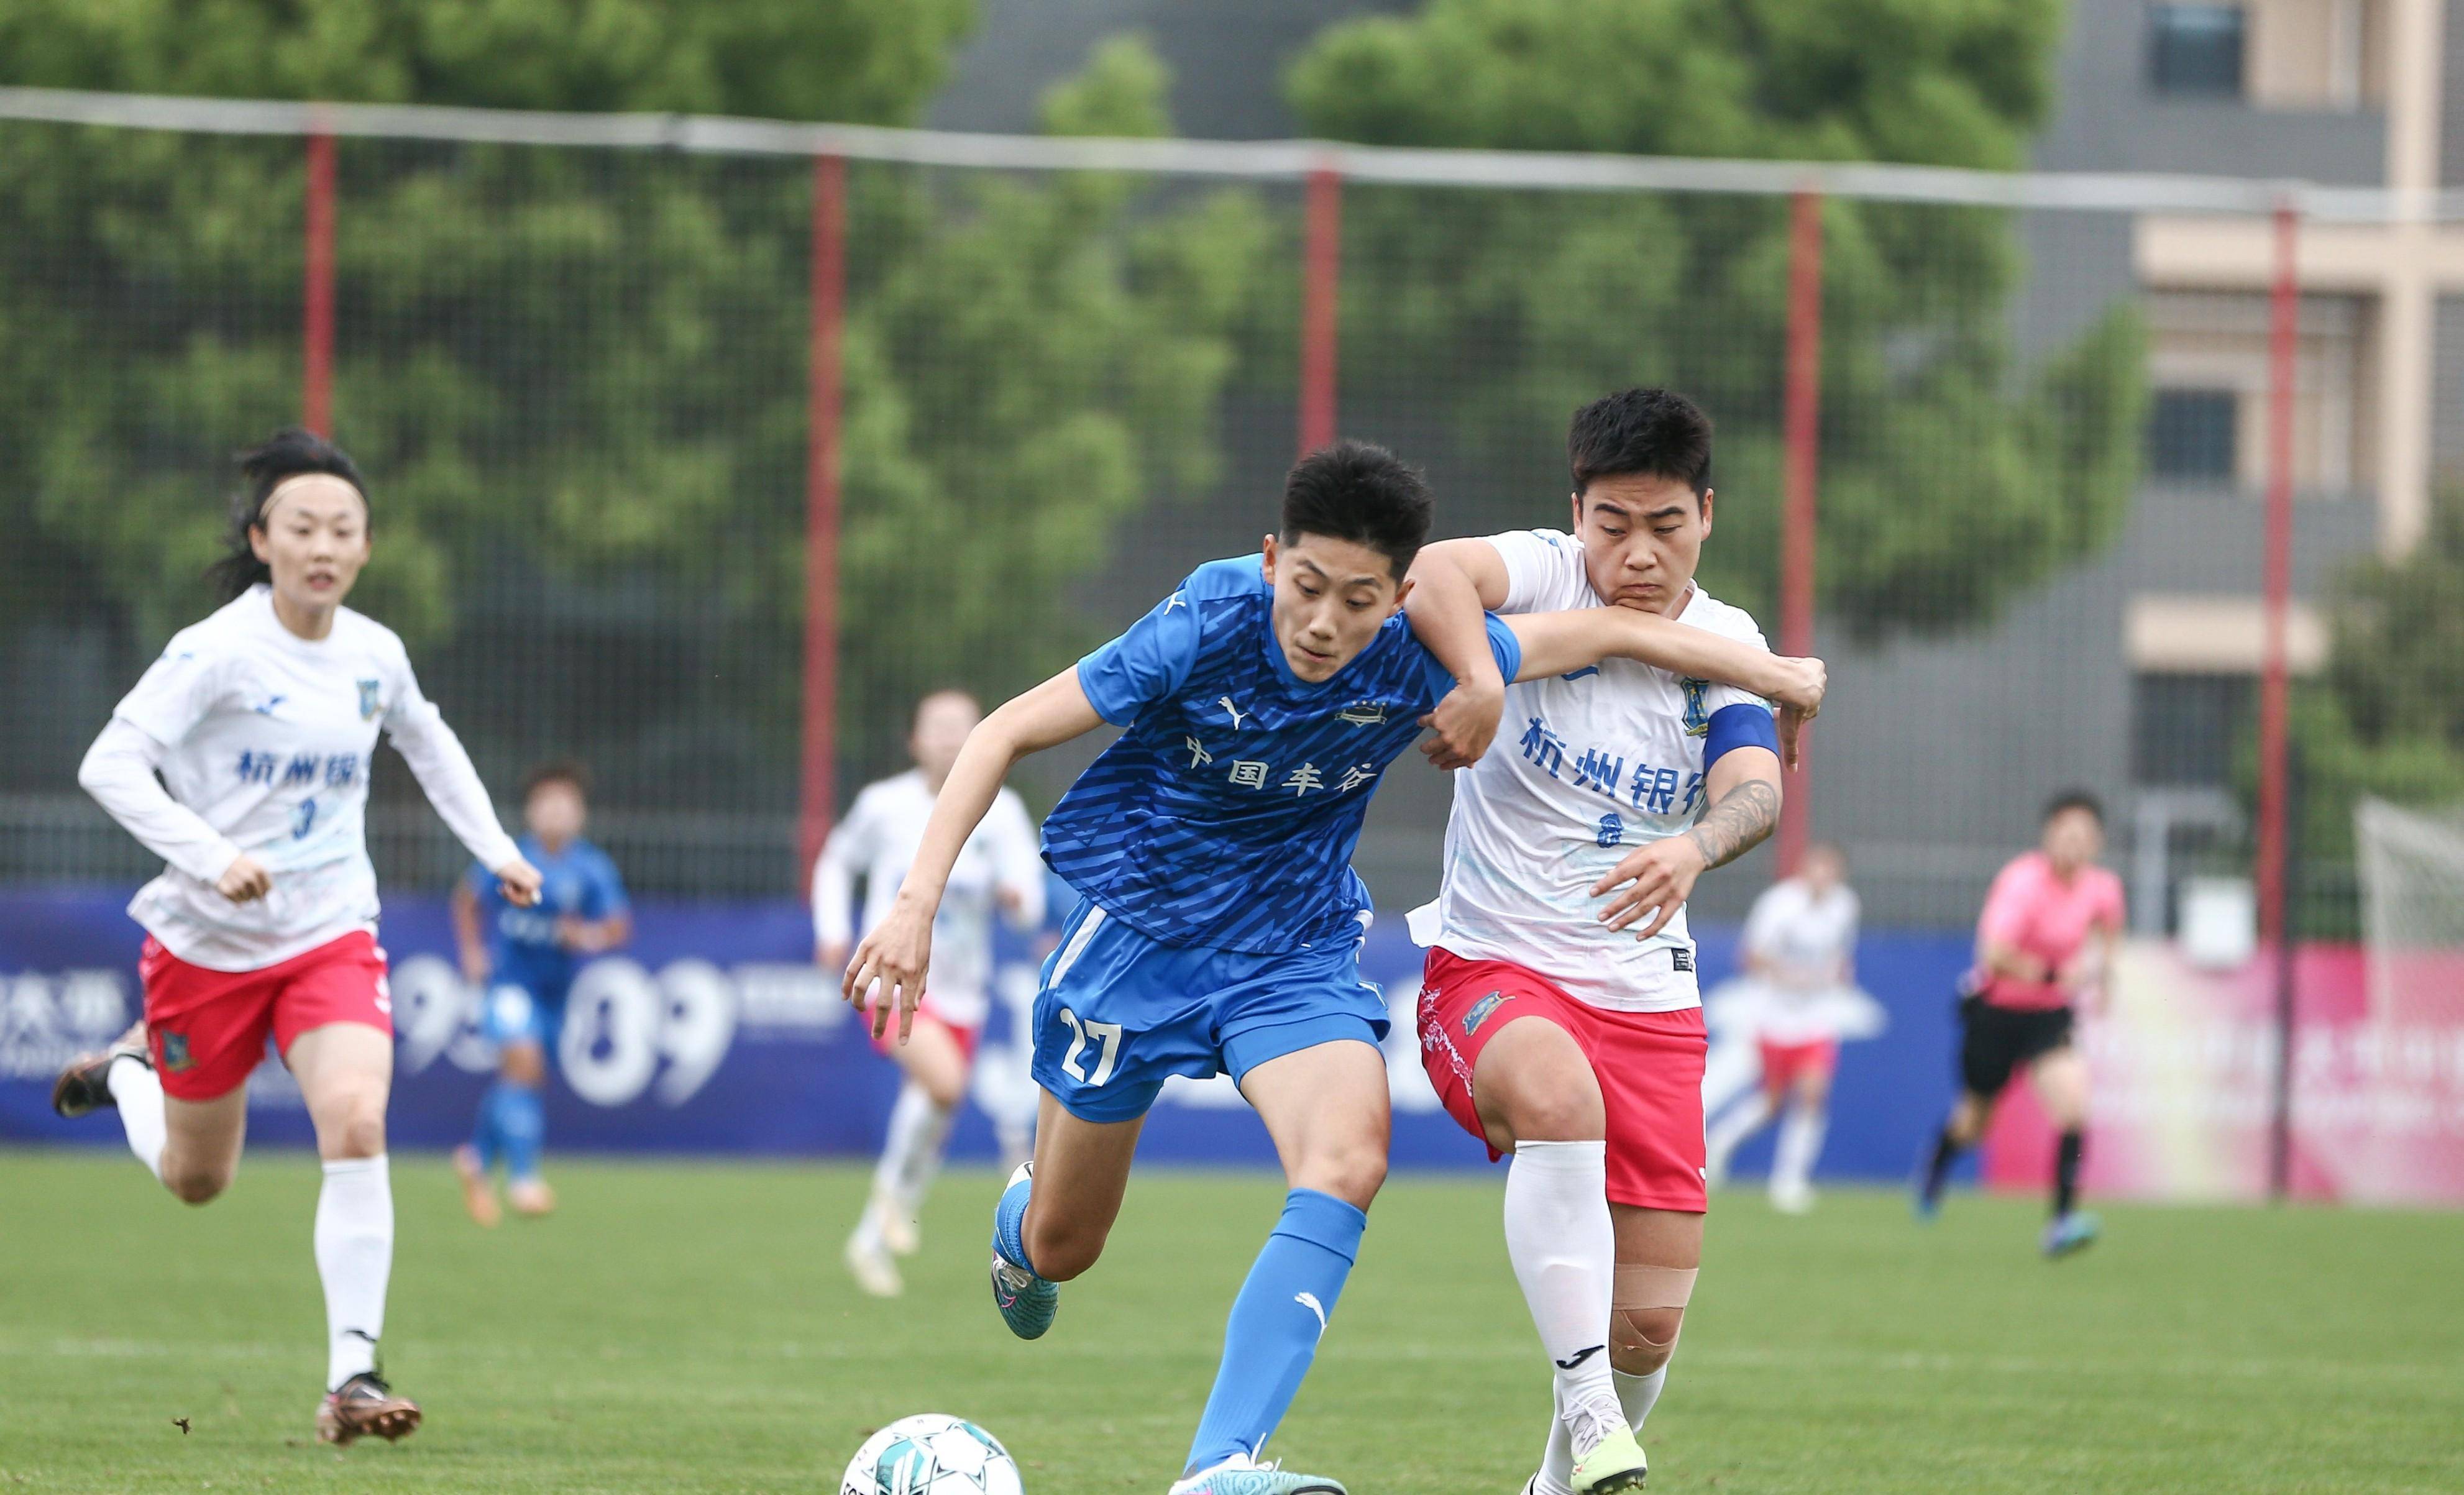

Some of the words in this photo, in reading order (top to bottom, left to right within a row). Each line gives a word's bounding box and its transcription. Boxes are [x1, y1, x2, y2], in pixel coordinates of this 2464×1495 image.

[1186, 736, 1378, 797] 中国车谷
[1059, 1008, 1122, 1087] 27
